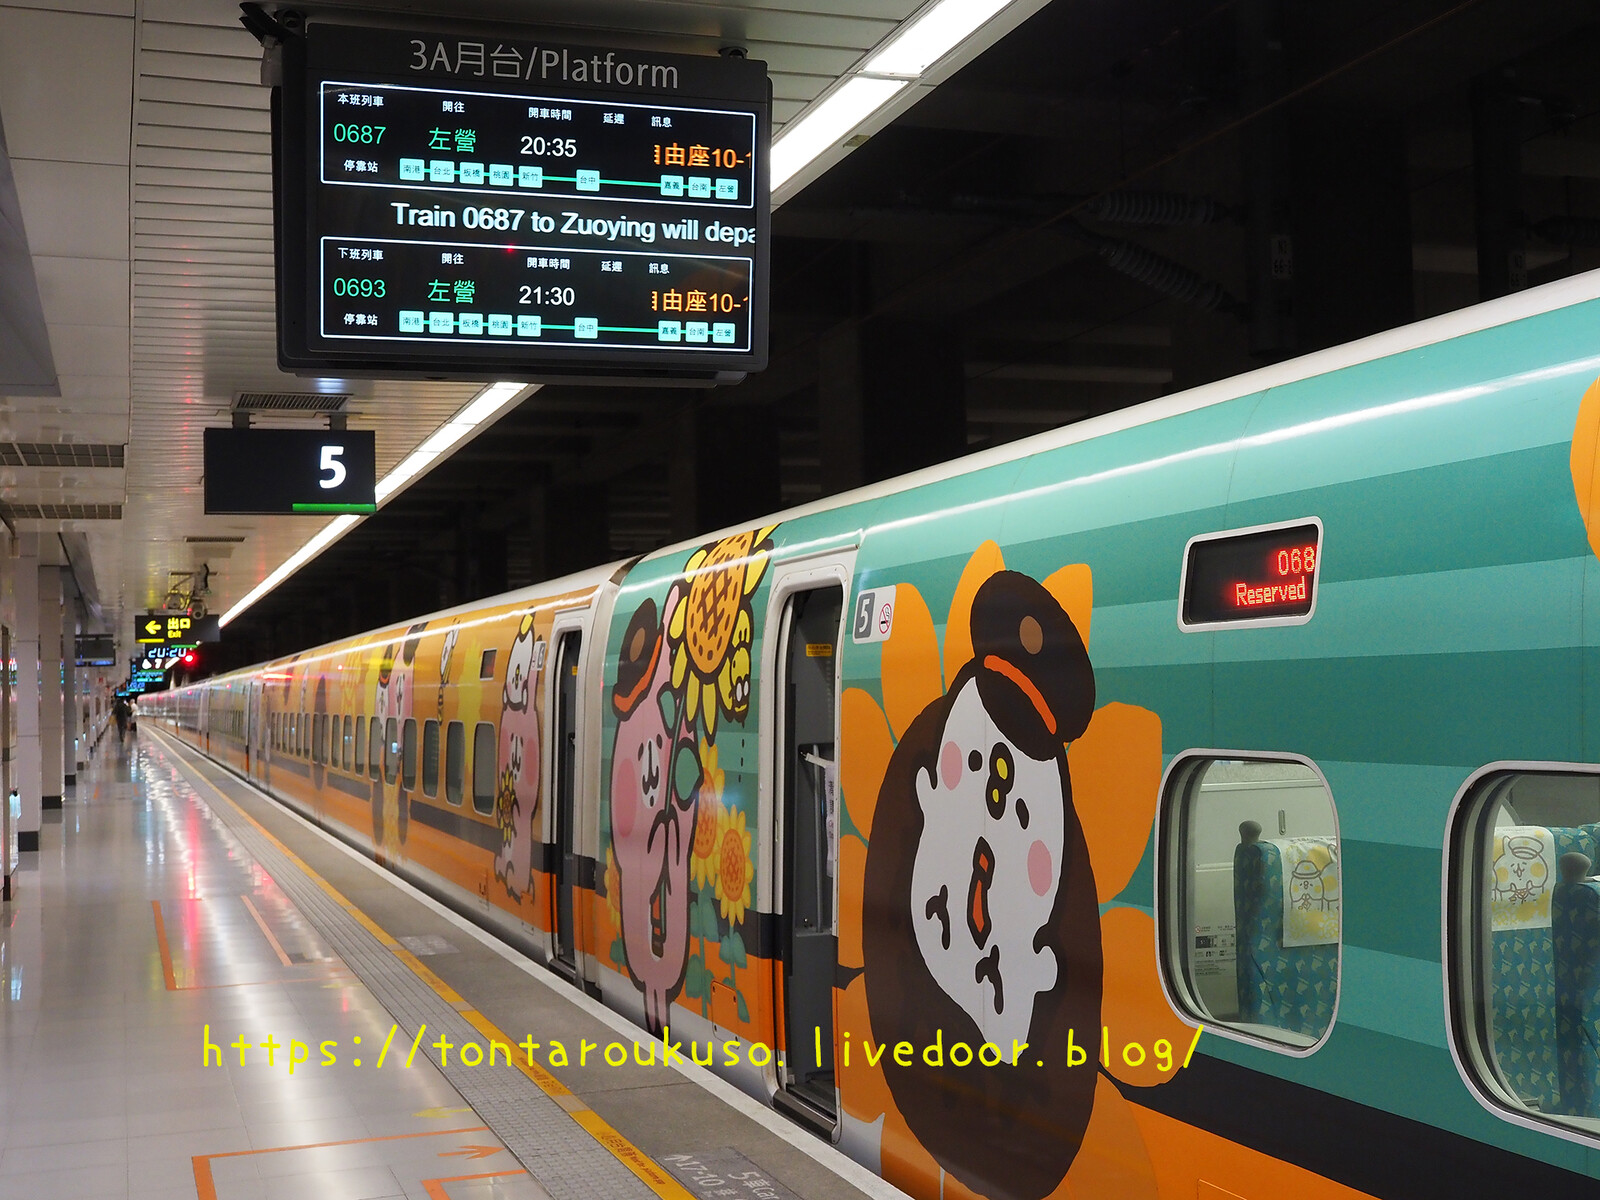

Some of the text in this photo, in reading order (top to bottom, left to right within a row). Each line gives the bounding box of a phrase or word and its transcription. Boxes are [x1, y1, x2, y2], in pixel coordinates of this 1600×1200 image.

[337, 93, 384, 107] 本班列車
[442, 101, 465, 113] 開往
[528, 107, 572, 121] 開車時間
[602, 113, 625, 125] 延遲
[651, 116, 672, 128] 訊息
[333, 123, 387, 145] 0687
[428, 127, 477, 153] 左營
[520, 135, 577, 158] 20:35
[343, 159, 379, 173] 停靠站
[390, 202, 456, 227] Train
[462, 206, 526, 231] 0687
[531, 211, 555, 233] to
[560, 212, 656, 243] Zuoying
[661, 218, 698, 241] will
[337, 247, 384, 261] 下班列車
[441, 253, 464, 265] 開往
[526, 257, 571, 270] 開車時間
[600, 260, 623, 273] 延遲
[648, 262, 670, 275] 訊息
[333, 277, 386, 298] 0693
[427, 279, 476, 304] 左營
[518, 285, 576, 306] 21:30
[343, 313, 379, 326] 停靠站
[319, 445, 347, 489] 5
[1235, 576, 1306, 606] Reserved
[858, 598, 871, 633] 5
[167, 616, 191, 630] 出口
